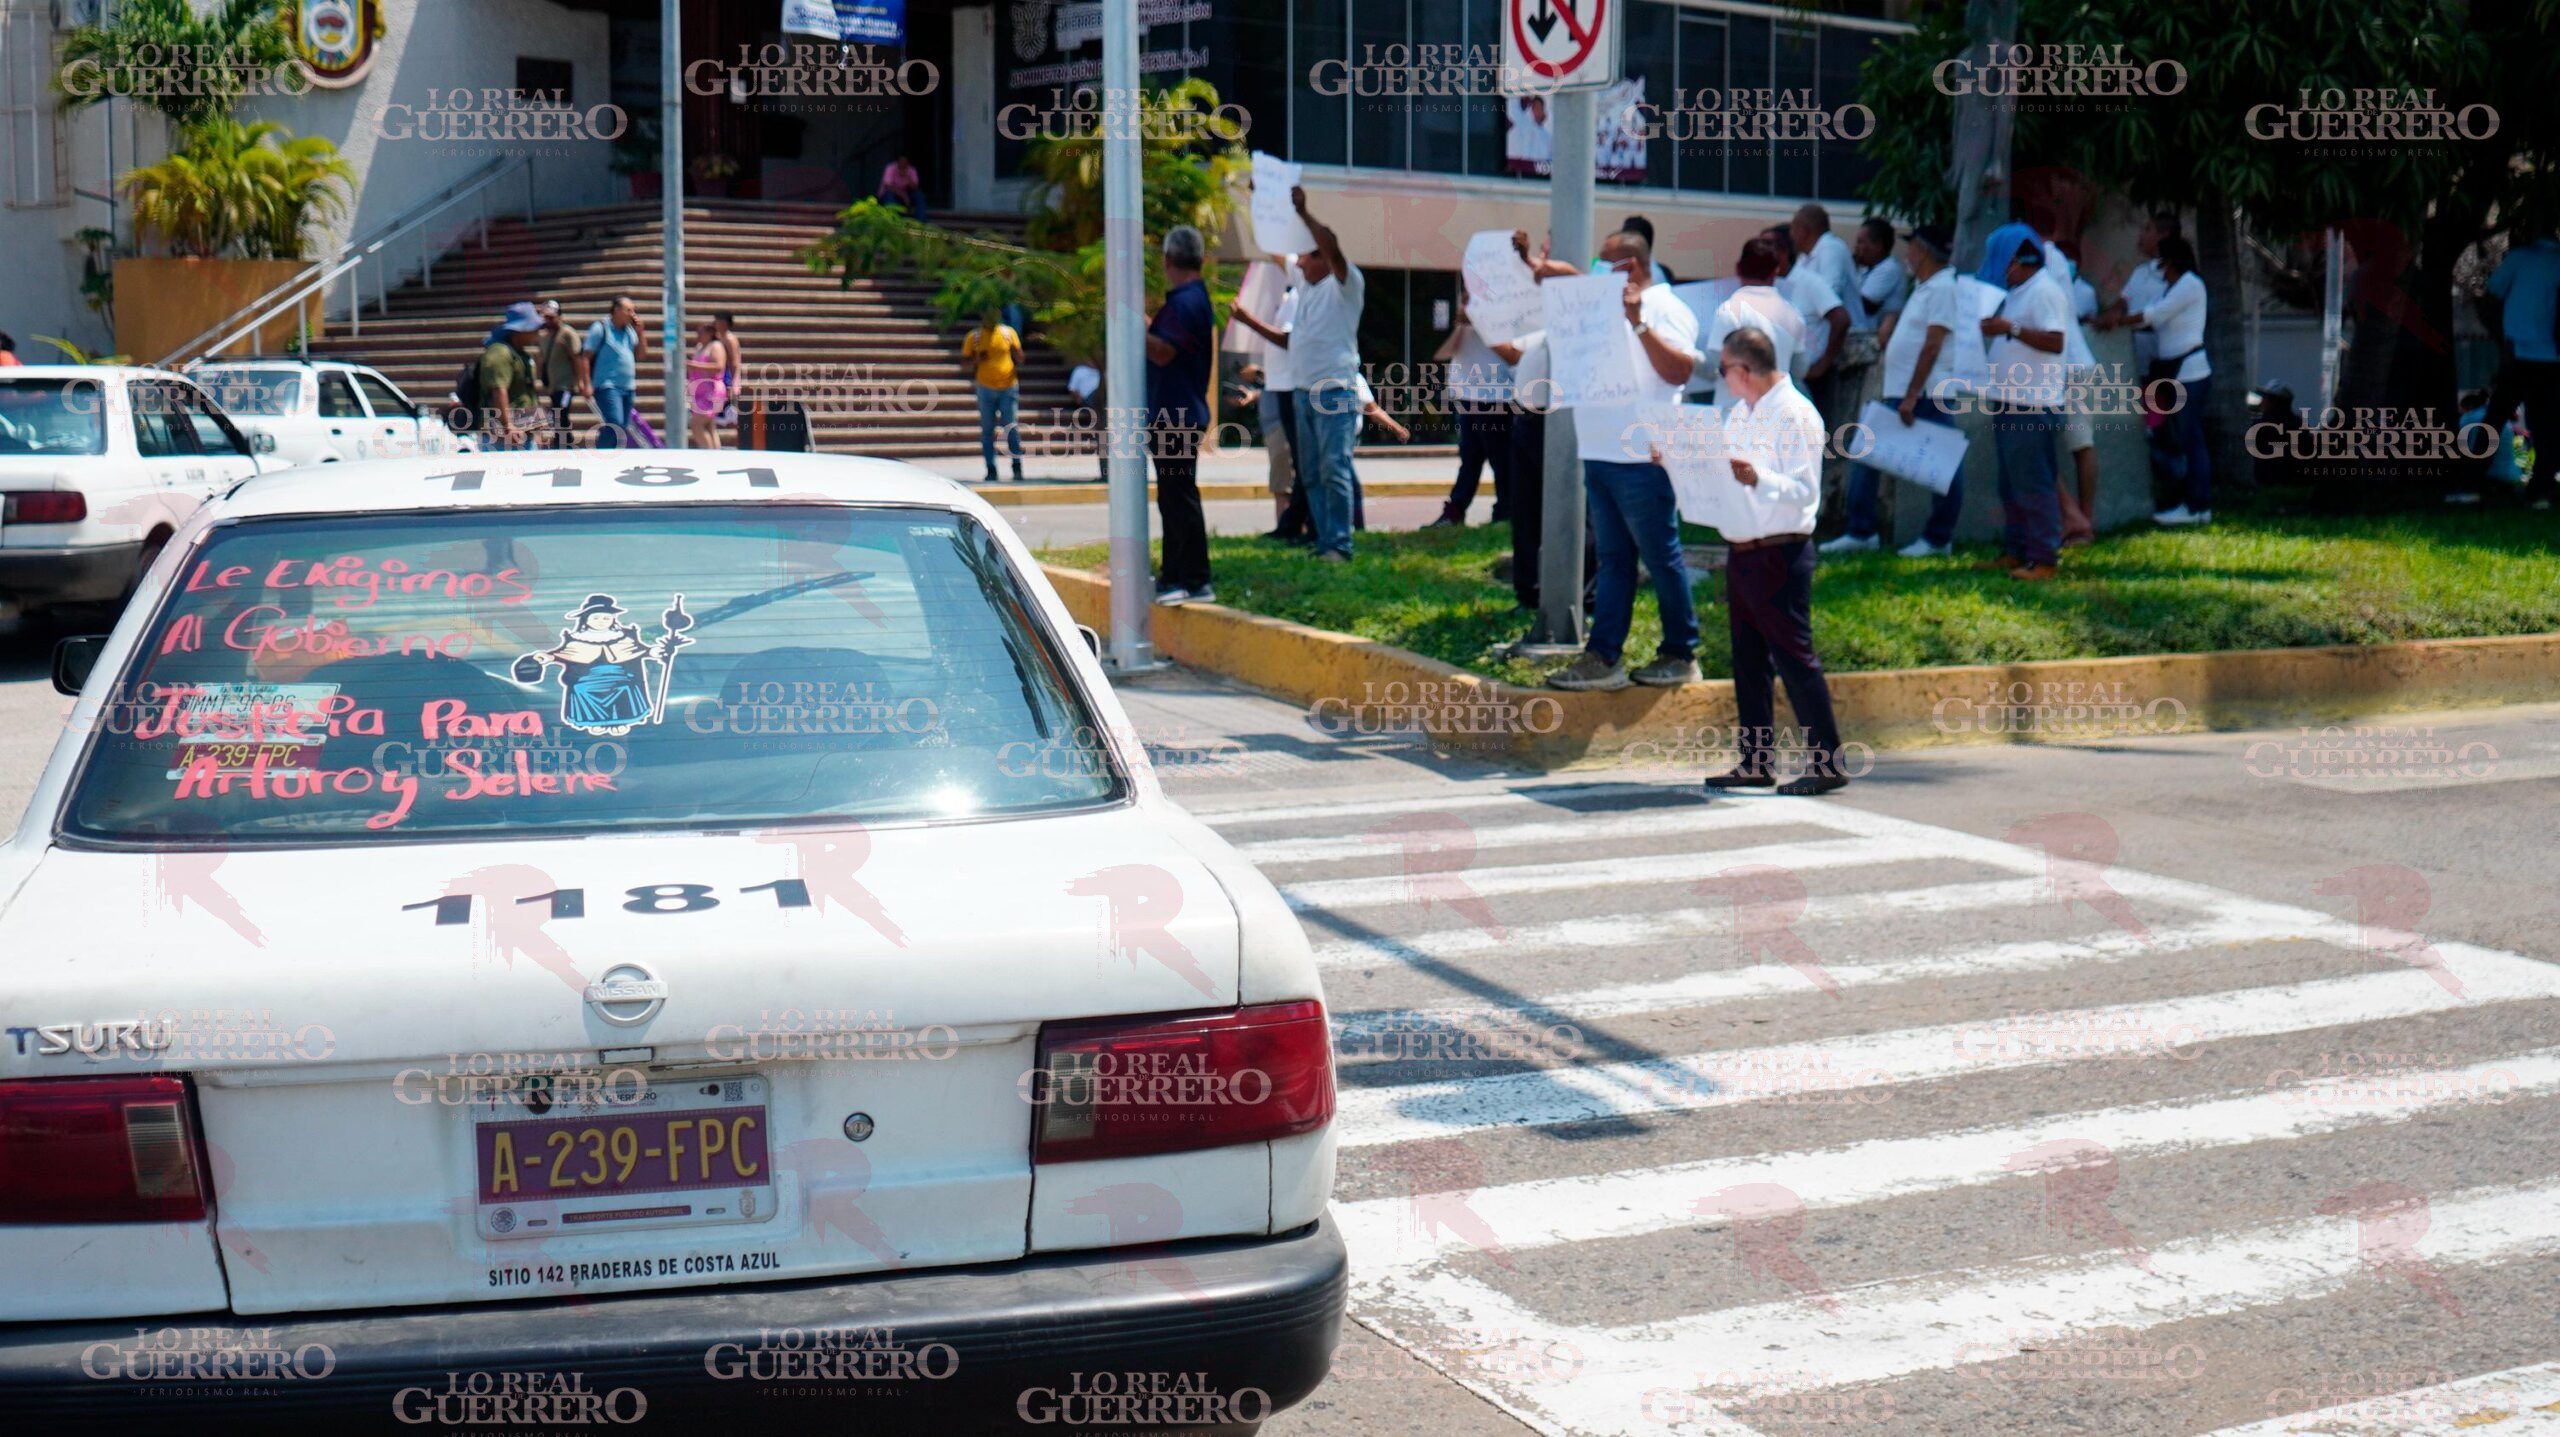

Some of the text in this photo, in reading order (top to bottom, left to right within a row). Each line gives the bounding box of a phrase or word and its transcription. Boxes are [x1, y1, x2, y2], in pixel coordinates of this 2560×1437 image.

[424, 465, 780, 491] 1181
[185, 560, 252, 593] Le
[421, 699, 544, 740] Para
[174, 753, 374, 800] Arturo
[402, 878, 813, 926] 1181
[592, 983, 658, 998] NISSAN
[5, 1019, 174, 1056] TSURU
[491, 1115, 759, 1194] A-239-FPC
[488, 1252, 780, 1286] SITIO 142 PRADERAS DE COSTA AZUL
